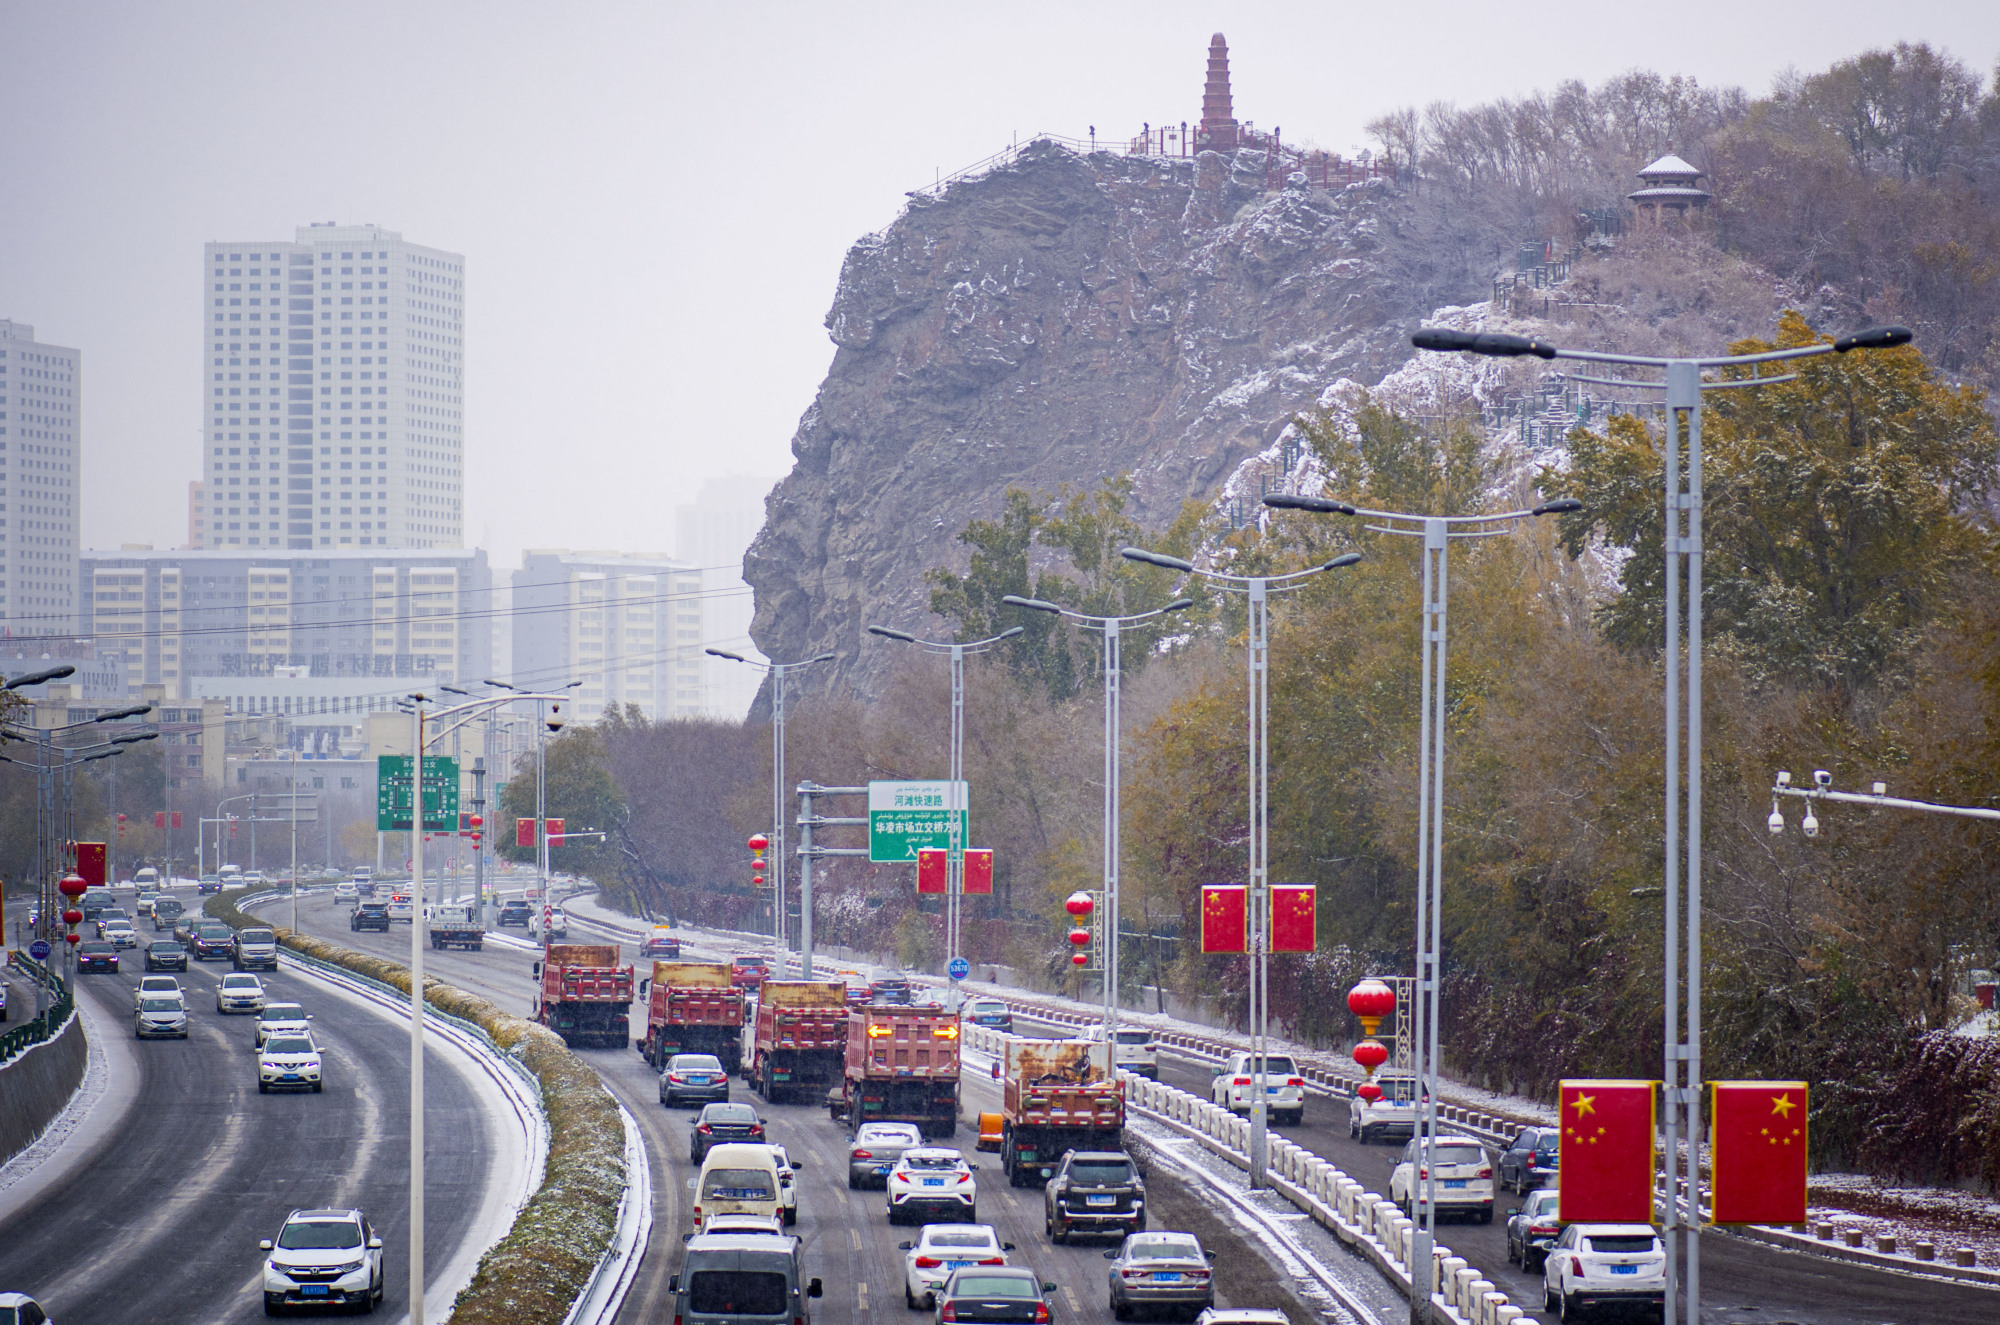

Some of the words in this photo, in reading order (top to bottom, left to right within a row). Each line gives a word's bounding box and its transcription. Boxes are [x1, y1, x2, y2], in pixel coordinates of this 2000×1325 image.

[894, 795, 943, 806] 河滩快速路
[950, 964, 968, 972] 53678
